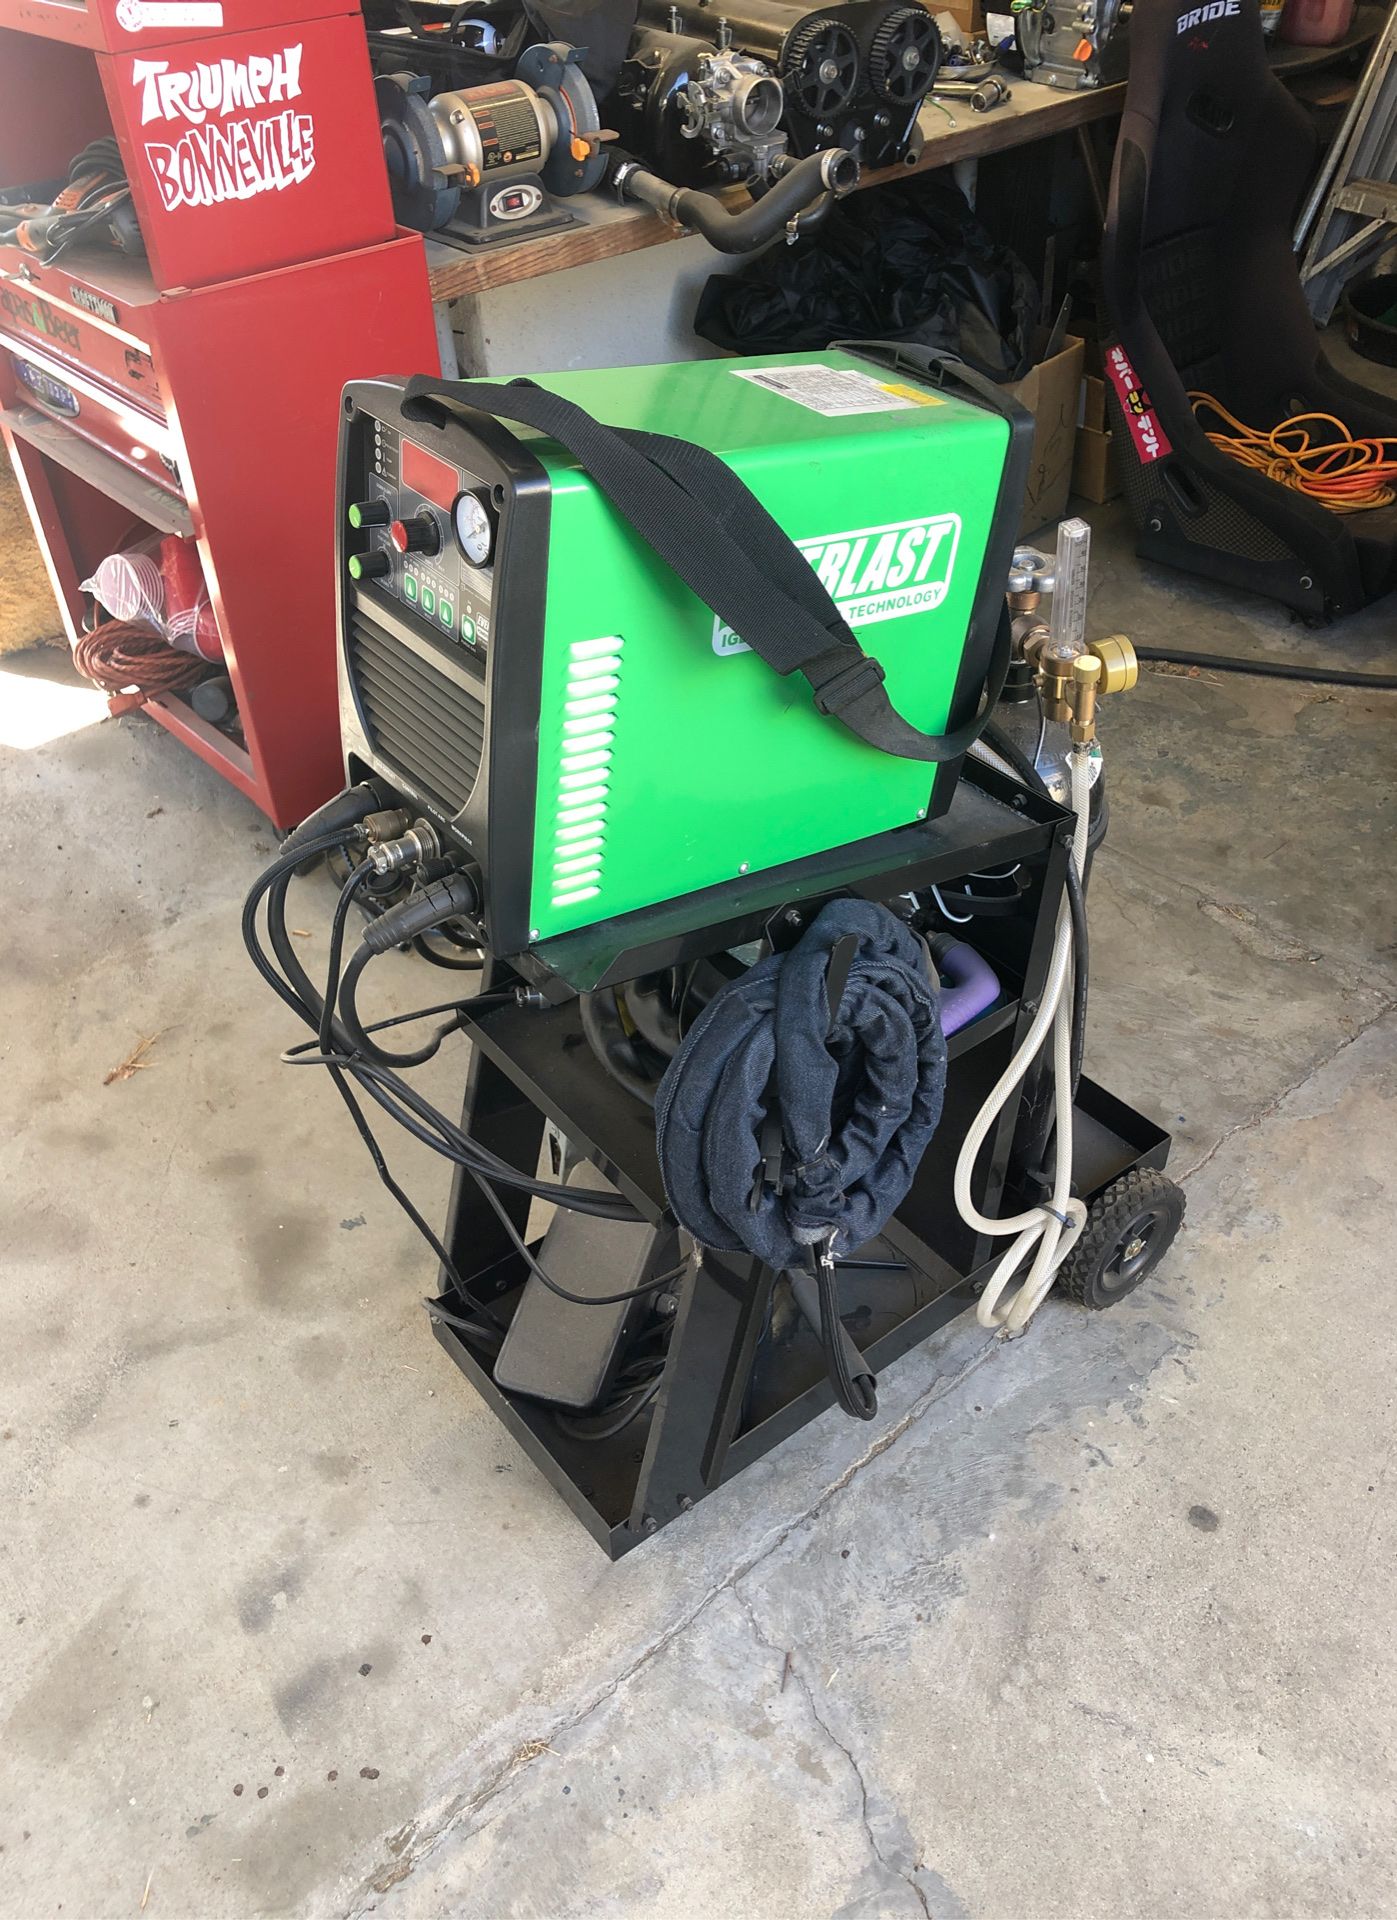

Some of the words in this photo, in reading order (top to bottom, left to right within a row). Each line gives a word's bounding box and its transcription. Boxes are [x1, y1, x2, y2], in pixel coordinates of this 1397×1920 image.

[1176, 0, 1241, 35] BRIDE
[133, 43, 302, 126] TRIUMPH
[144, 110, 316, 211] BONNEVILLE
[801, 521, 953, 599] RLAST
[849, 588, 941, 619] TECHNOLOGY
